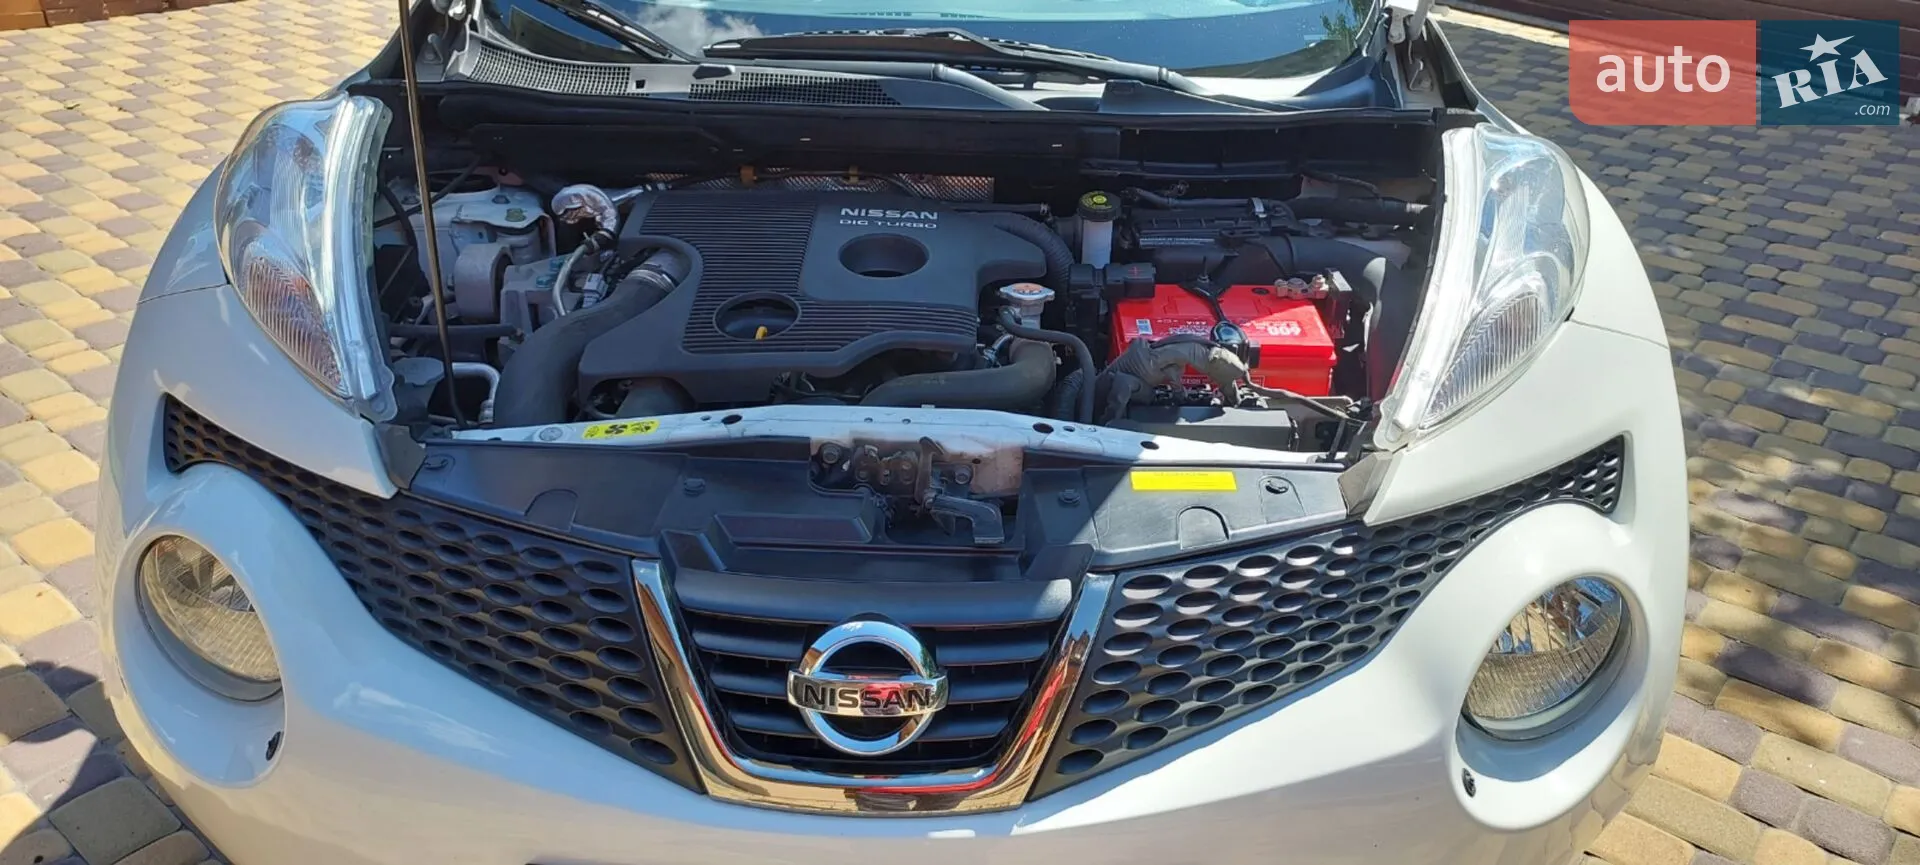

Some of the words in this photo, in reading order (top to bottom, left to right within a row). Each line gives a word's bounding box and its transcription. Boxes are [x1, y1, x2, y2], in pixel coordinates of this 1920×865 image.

[841, 208, 938, 220] NISSAN
[875, 220, 937, 229] TURBO
[803, 684, 930, 708] NISSAN
